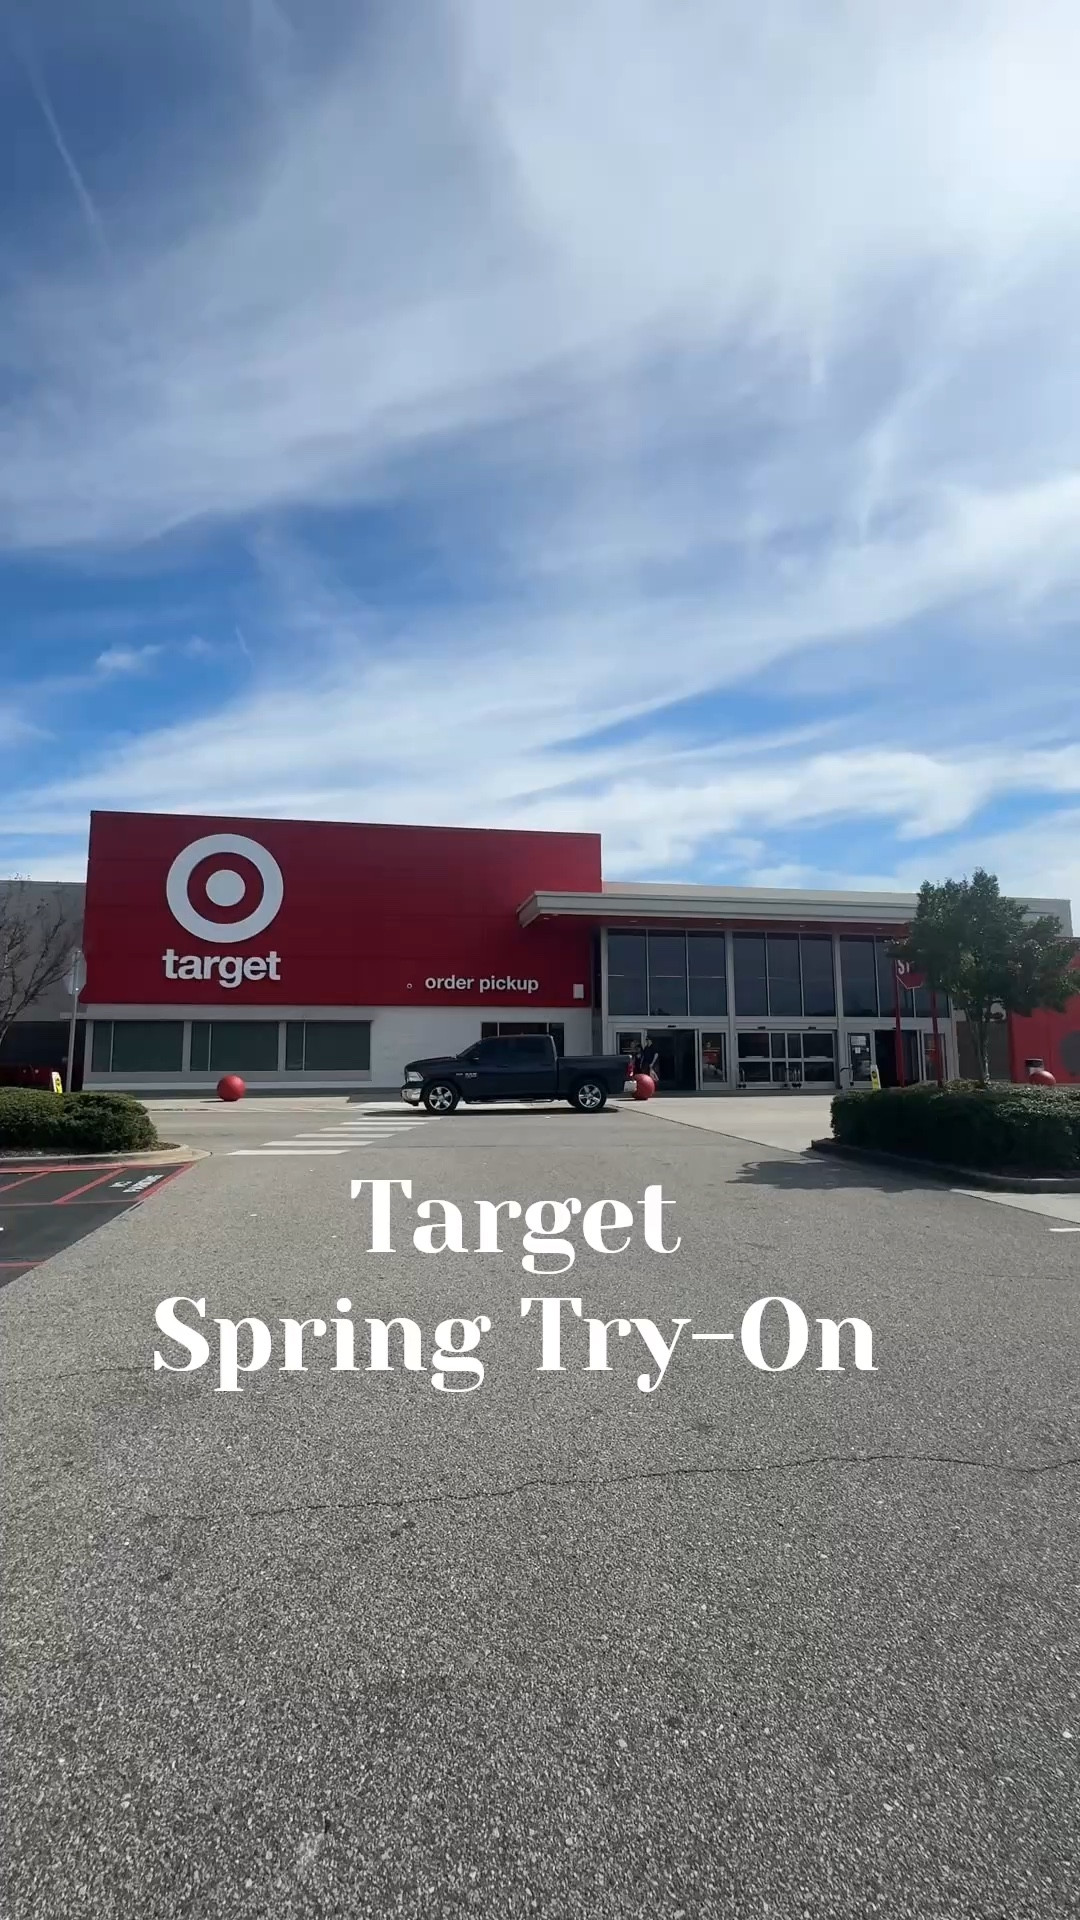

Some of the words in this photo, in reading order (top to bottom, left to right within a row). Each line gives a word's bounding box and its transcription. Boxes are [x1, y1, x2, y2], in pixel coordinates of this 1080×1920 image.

[162, 949, 282, 988] target
[424, 974, 475, 990] order
[479, 975, 539, 994] pickup
